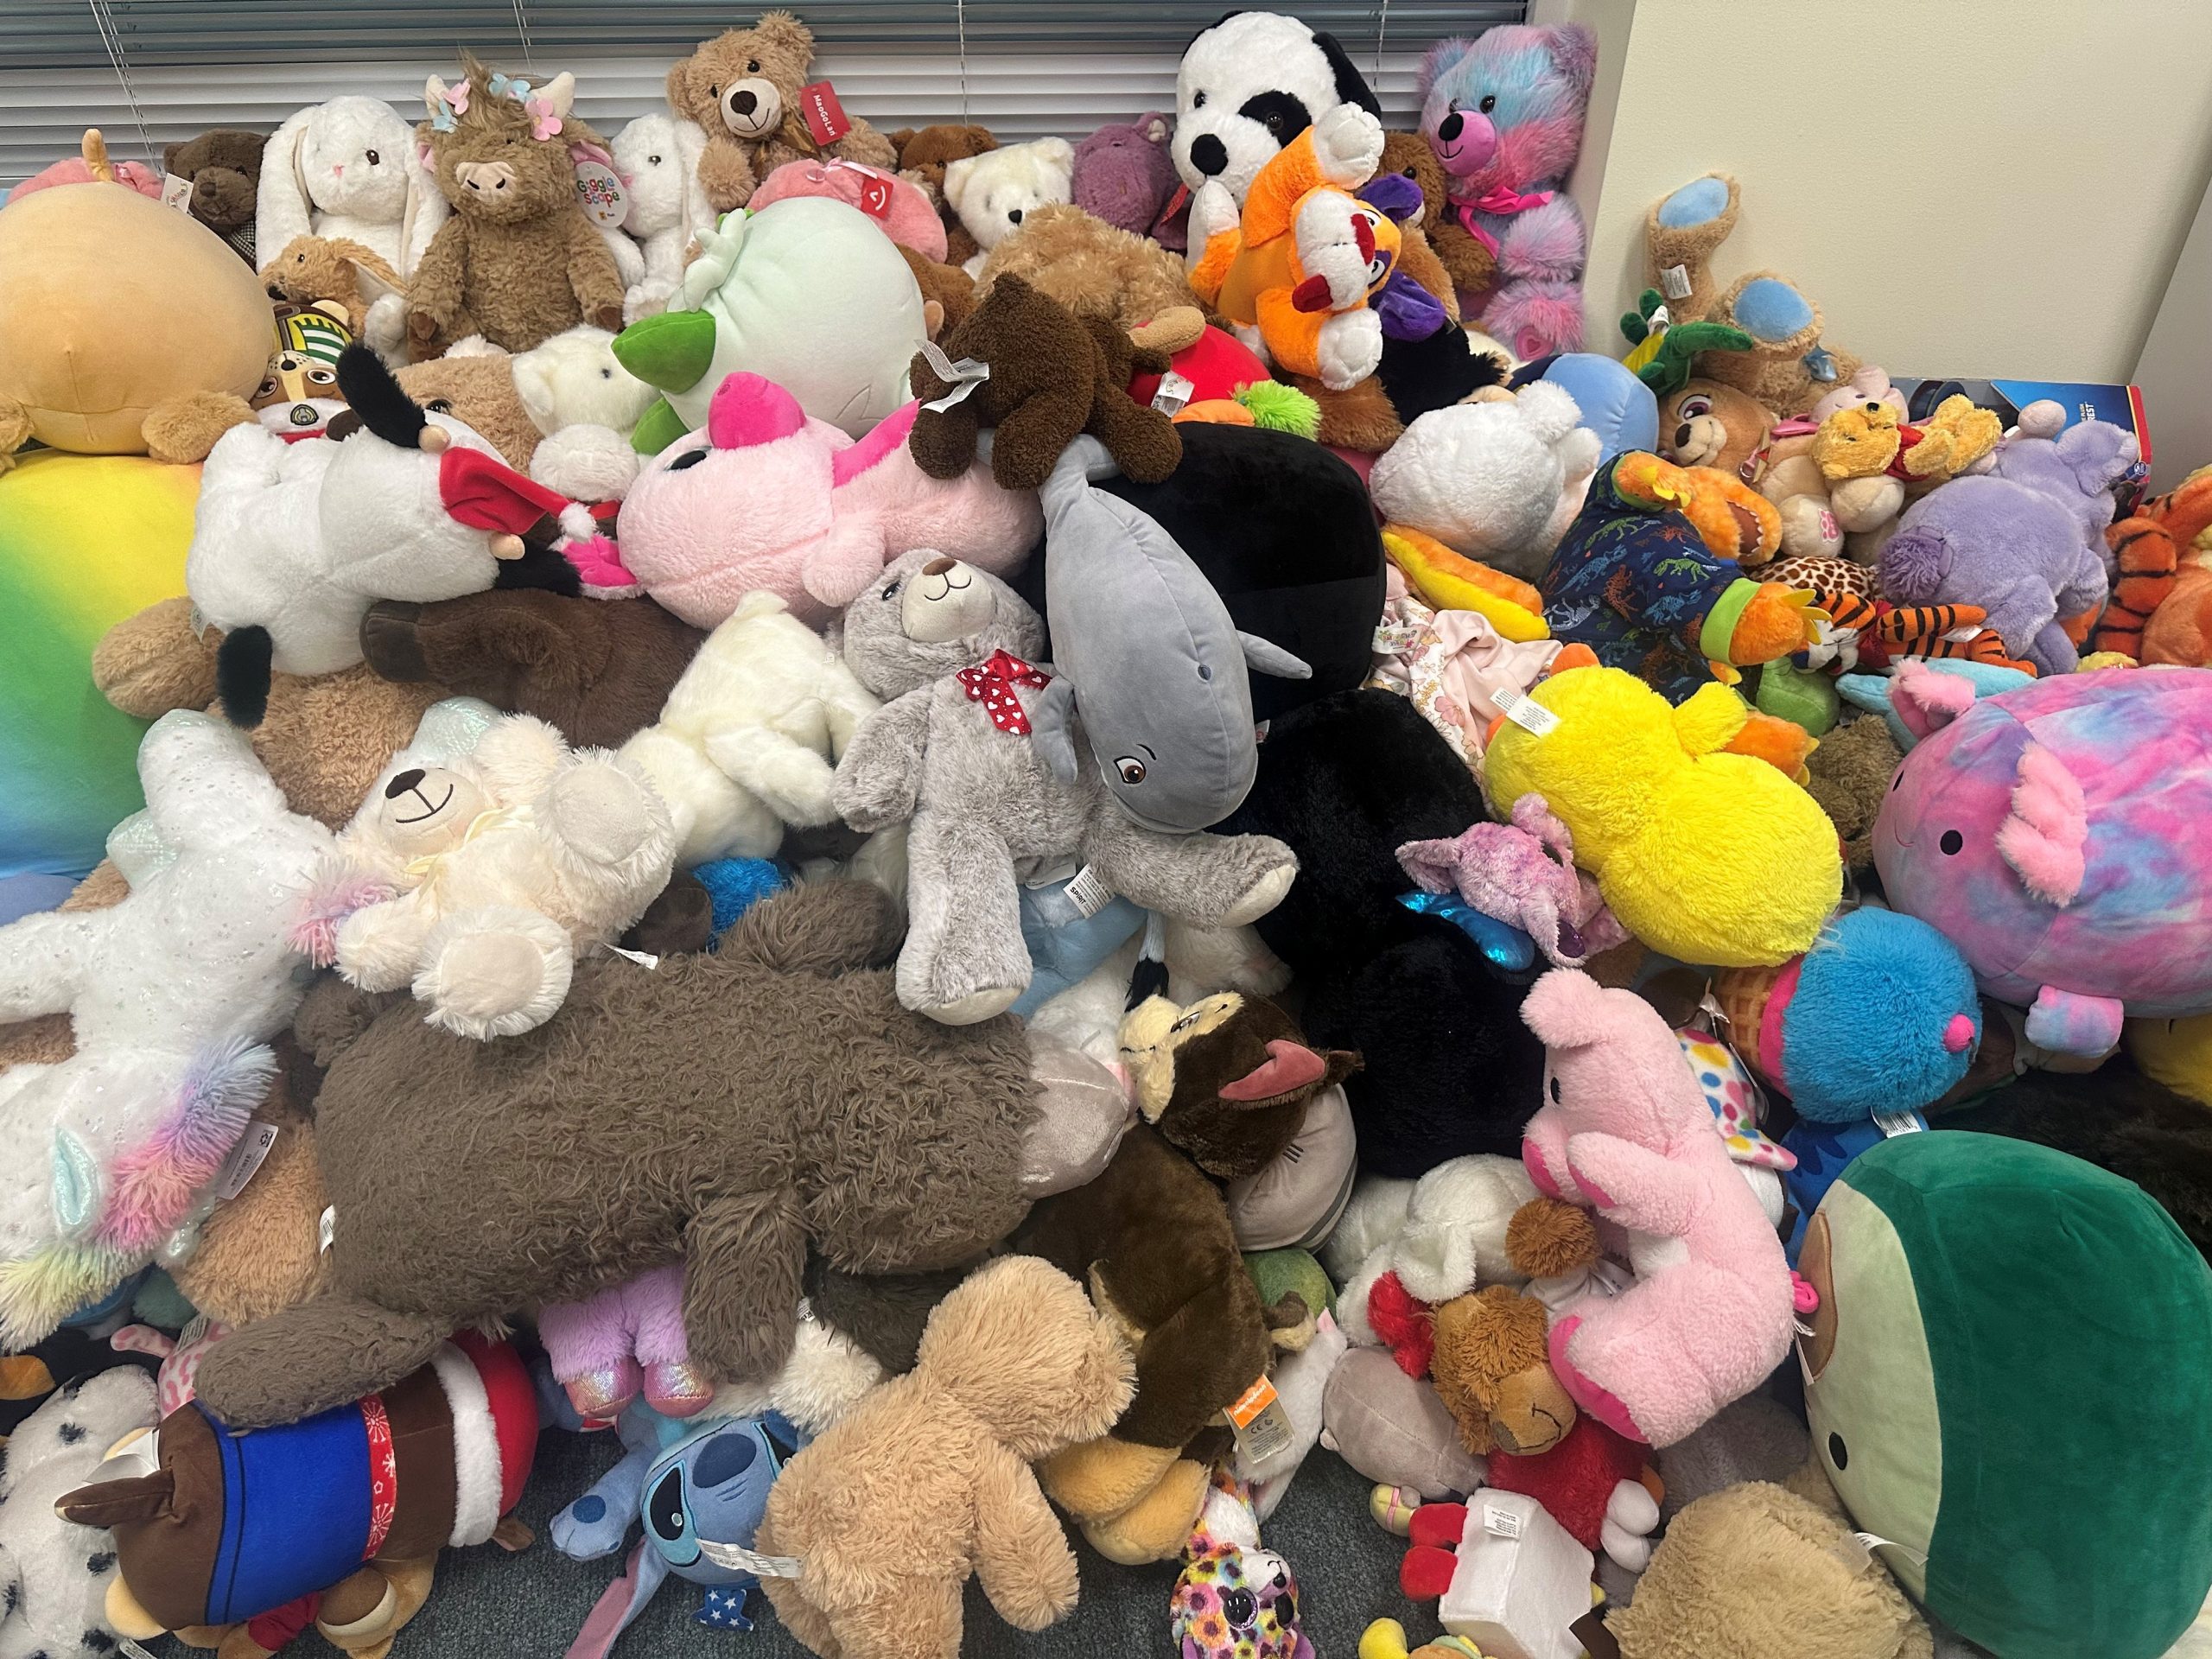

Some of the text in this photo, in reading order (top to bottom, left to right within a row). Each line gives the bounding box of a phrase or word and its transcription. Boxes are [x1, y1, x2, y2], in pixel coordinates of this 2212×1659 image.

[813, 94, 836, 137] MaoGoLan
[576, 176, 615, 194] Giggle
[1070, 887, 1086, 905] SPIRIT
